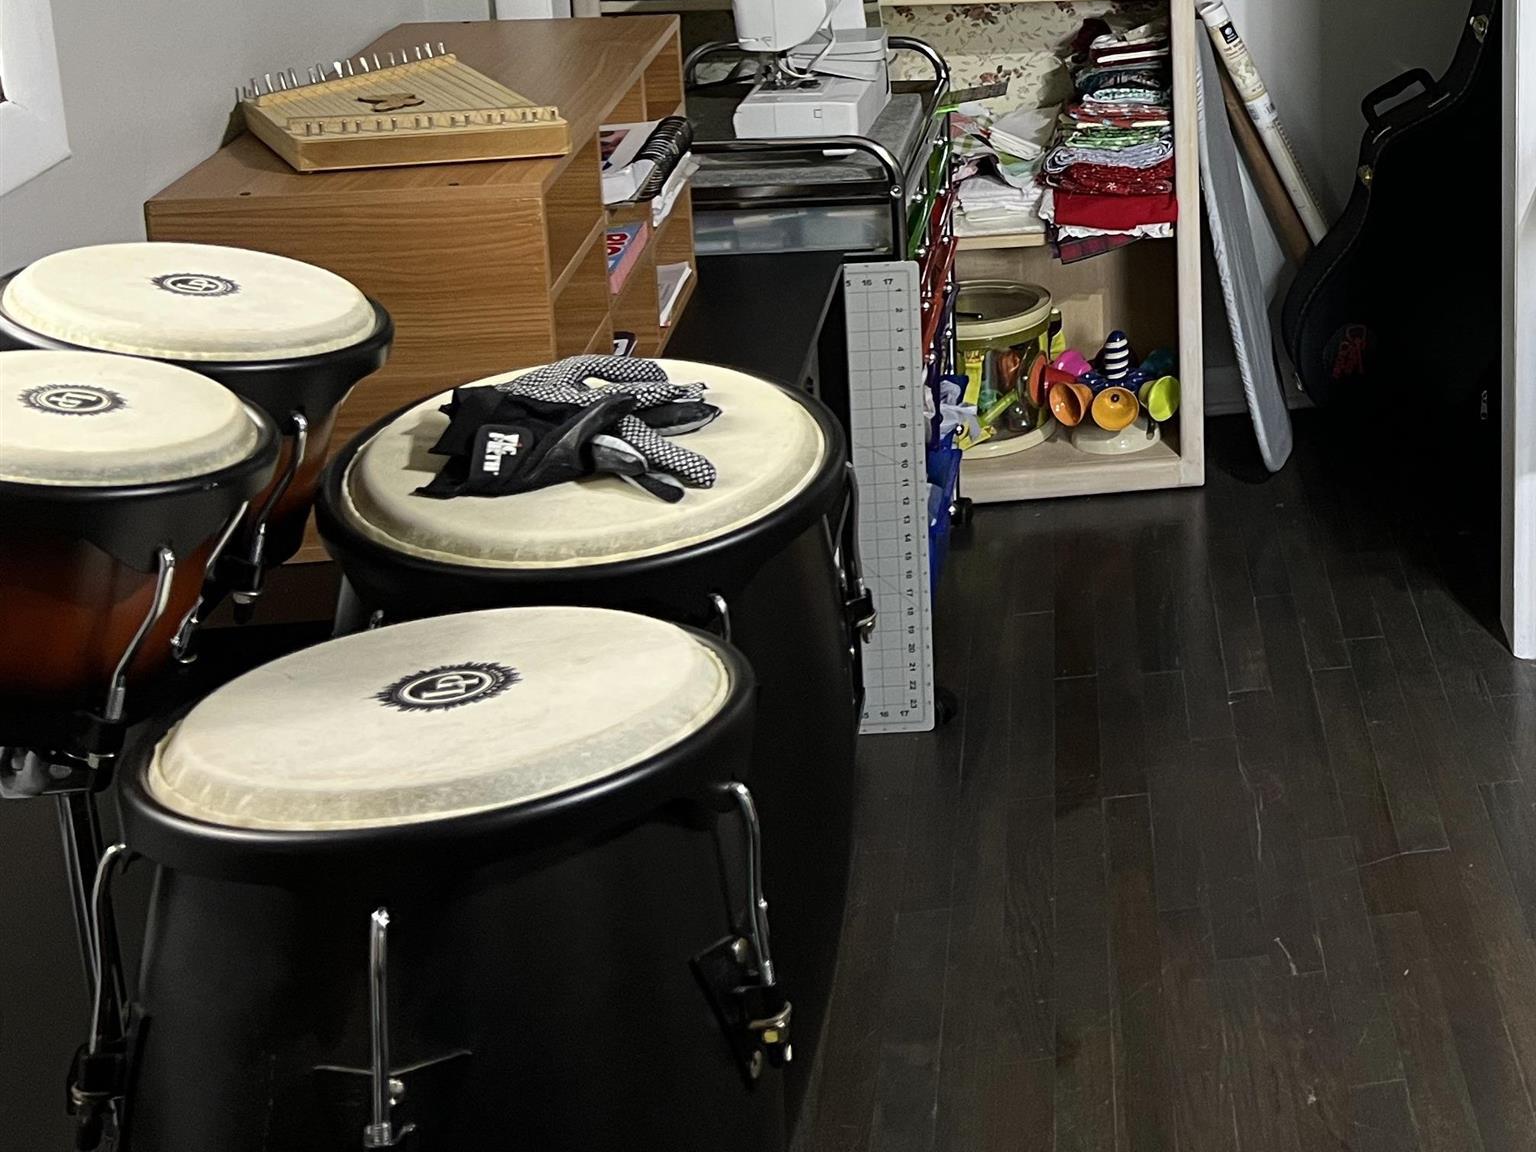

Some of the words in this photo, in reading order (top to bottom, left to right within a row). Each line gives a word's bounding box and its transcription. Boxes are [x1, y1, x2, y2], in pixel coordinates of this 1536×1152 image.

[901, 459, 908, 468] 10
[902, 479, 909, 487] 11
[903, 497, 910, 505] 12
[904, 515, 910, 524] 13
[904, 534, 911, 542] 14
[905, 552, 912, 560] 15
[907, 589, 913, 597] 17
[908, 626, 914, 634] 19
[908, 643, 915, 653] 20
[909, 662, 916, 671] 21
[422, 675, 480, 699] LP
[910, 680, 916, 690] 22
[910, 699, 917, 708] 23
